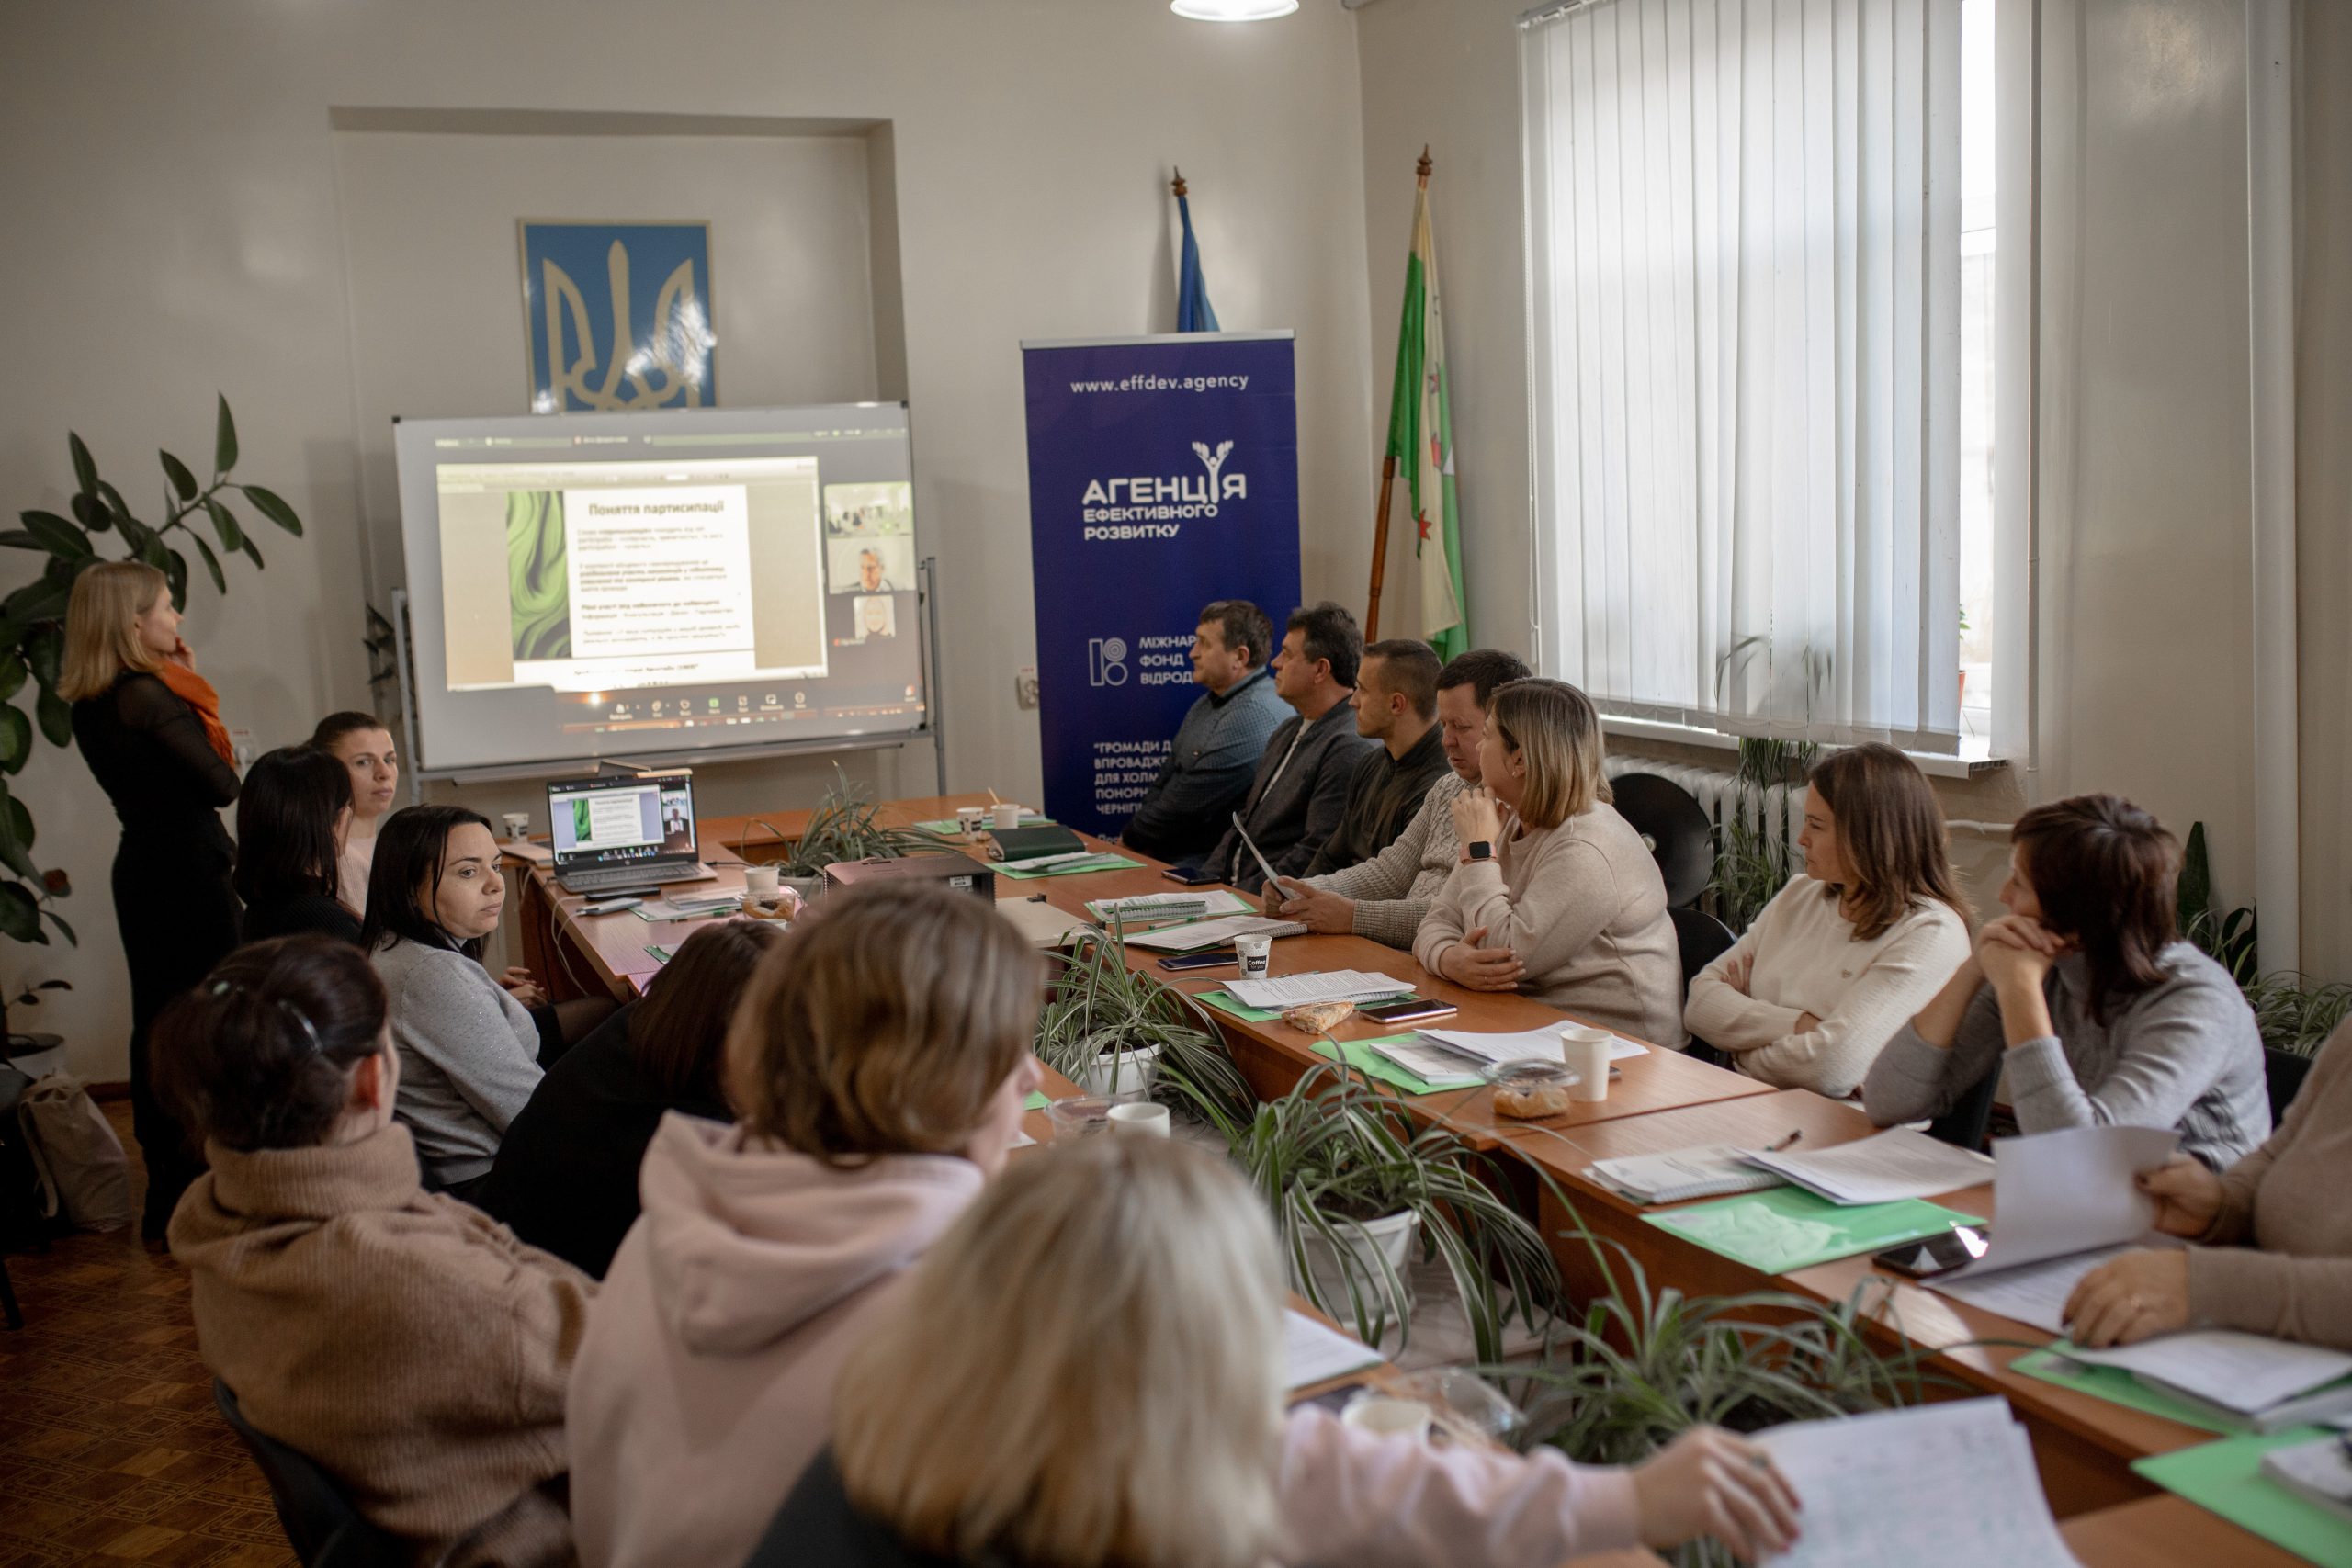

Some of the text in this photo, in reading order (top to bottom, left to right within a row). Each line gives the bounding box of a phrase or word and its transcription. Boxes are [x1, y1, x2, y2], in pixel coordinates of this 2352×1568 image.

[1070, 374, 1249, 393] www.effdev.agency
[588, 500, 724, 516] Поняття партисипації
[1083, 504, 1218, 523] ЕФЕКТИВНОГО
[1084, 524, 1180, 541] РОЗВИТКУ
[1139, 653, 1184, 667] ФОНД
[1140, 671, 1194, 685] ВІДРОД
[1094, 773, 1119, 785] ДЛЯ
